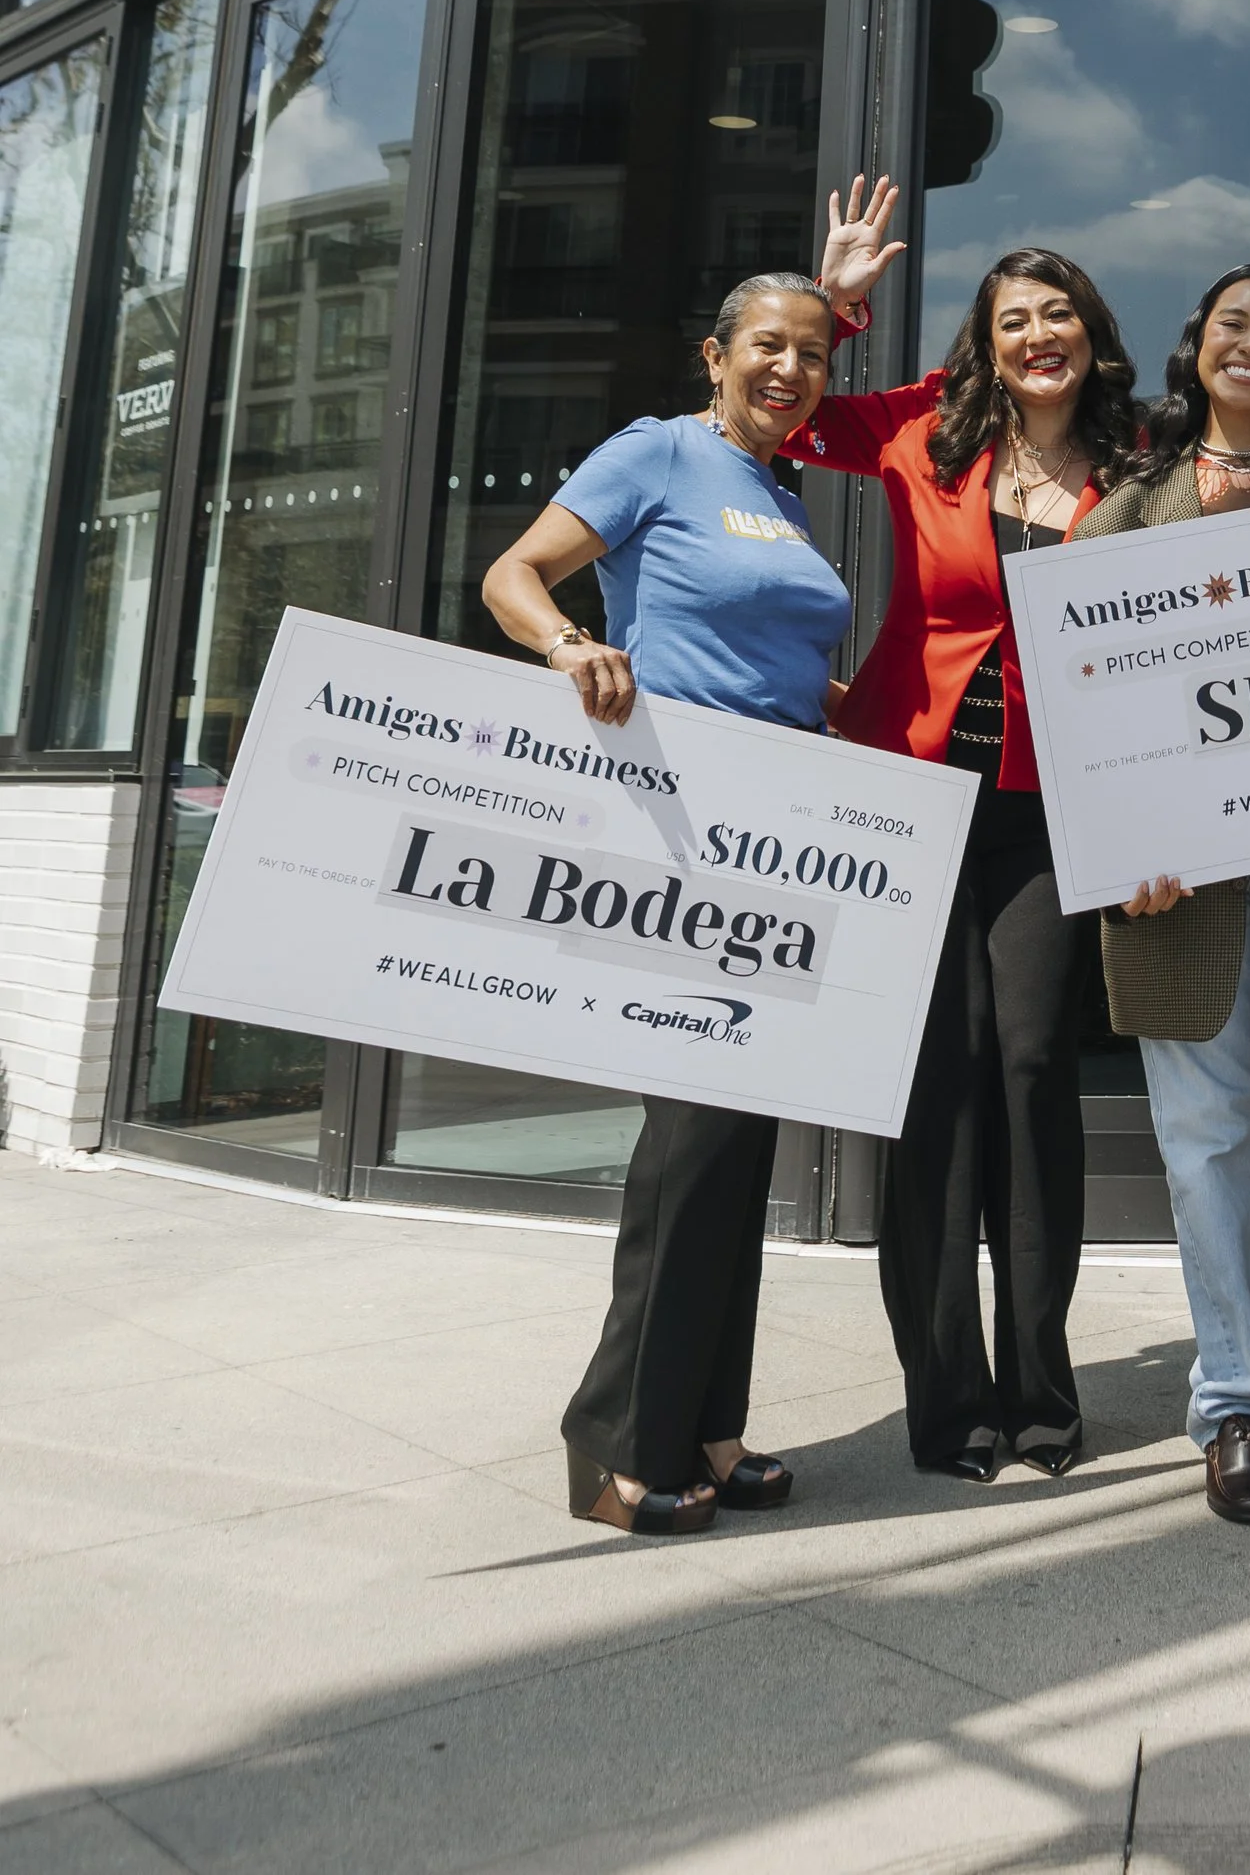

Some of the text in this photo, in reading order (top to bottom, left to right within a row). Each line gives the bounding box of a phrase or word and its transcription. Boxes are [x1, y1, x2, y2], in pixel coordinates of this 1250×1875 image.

[1059, 584, 1199, 632] Amigas
[1210, 583, 1227, 599] in
[1106, 648, 1166, 674] PITCH
[304, 681, 680, 795] Amigas in Business
[1084, 744, 1189, 773] PAY TO THE ORDER OF
[332, 756, 565, 824] PITCH COMPETITION
[790, 804, 813, 817] DATE
[830, 805, 914, 837] 3/28/2024
[258, 857, 376, 888] PAY TO THE ORDER OF
[666, 852, 685, 863] USD
[391, 826, 816, 978] La Bodega
[375, 954, 558, 1006] #WEALLGROW
